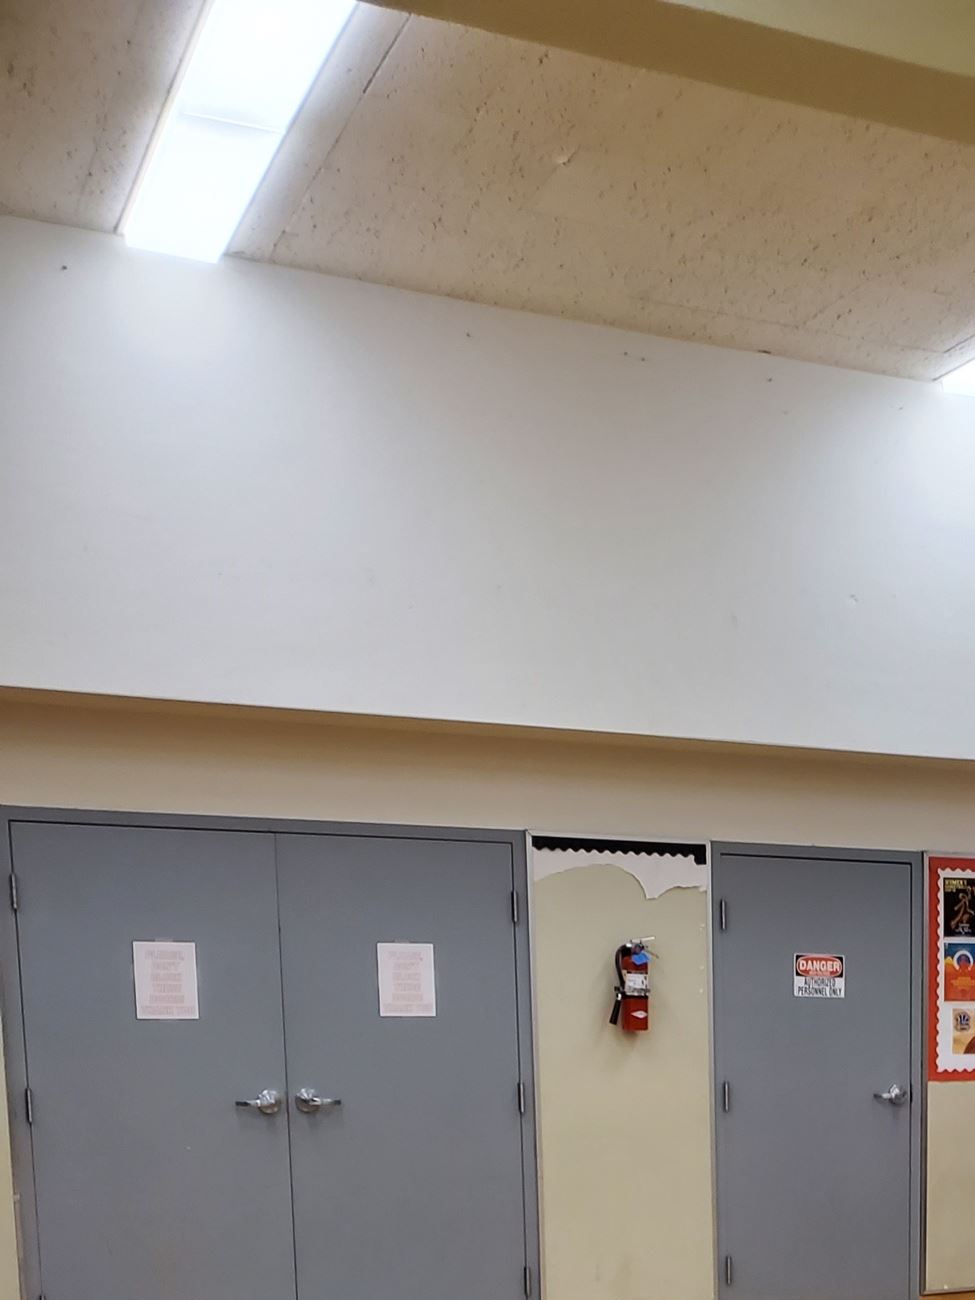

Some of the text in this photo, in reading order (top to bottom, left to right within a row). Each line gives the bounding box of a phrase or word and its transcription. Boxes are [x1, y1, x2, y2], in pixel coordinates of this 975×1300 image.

[799, 960, 840, 972] DANGER
[804, 977, 836, 988] AUTHORIZED
[797, 986, 842, 996] PERSONNEL ONLY
